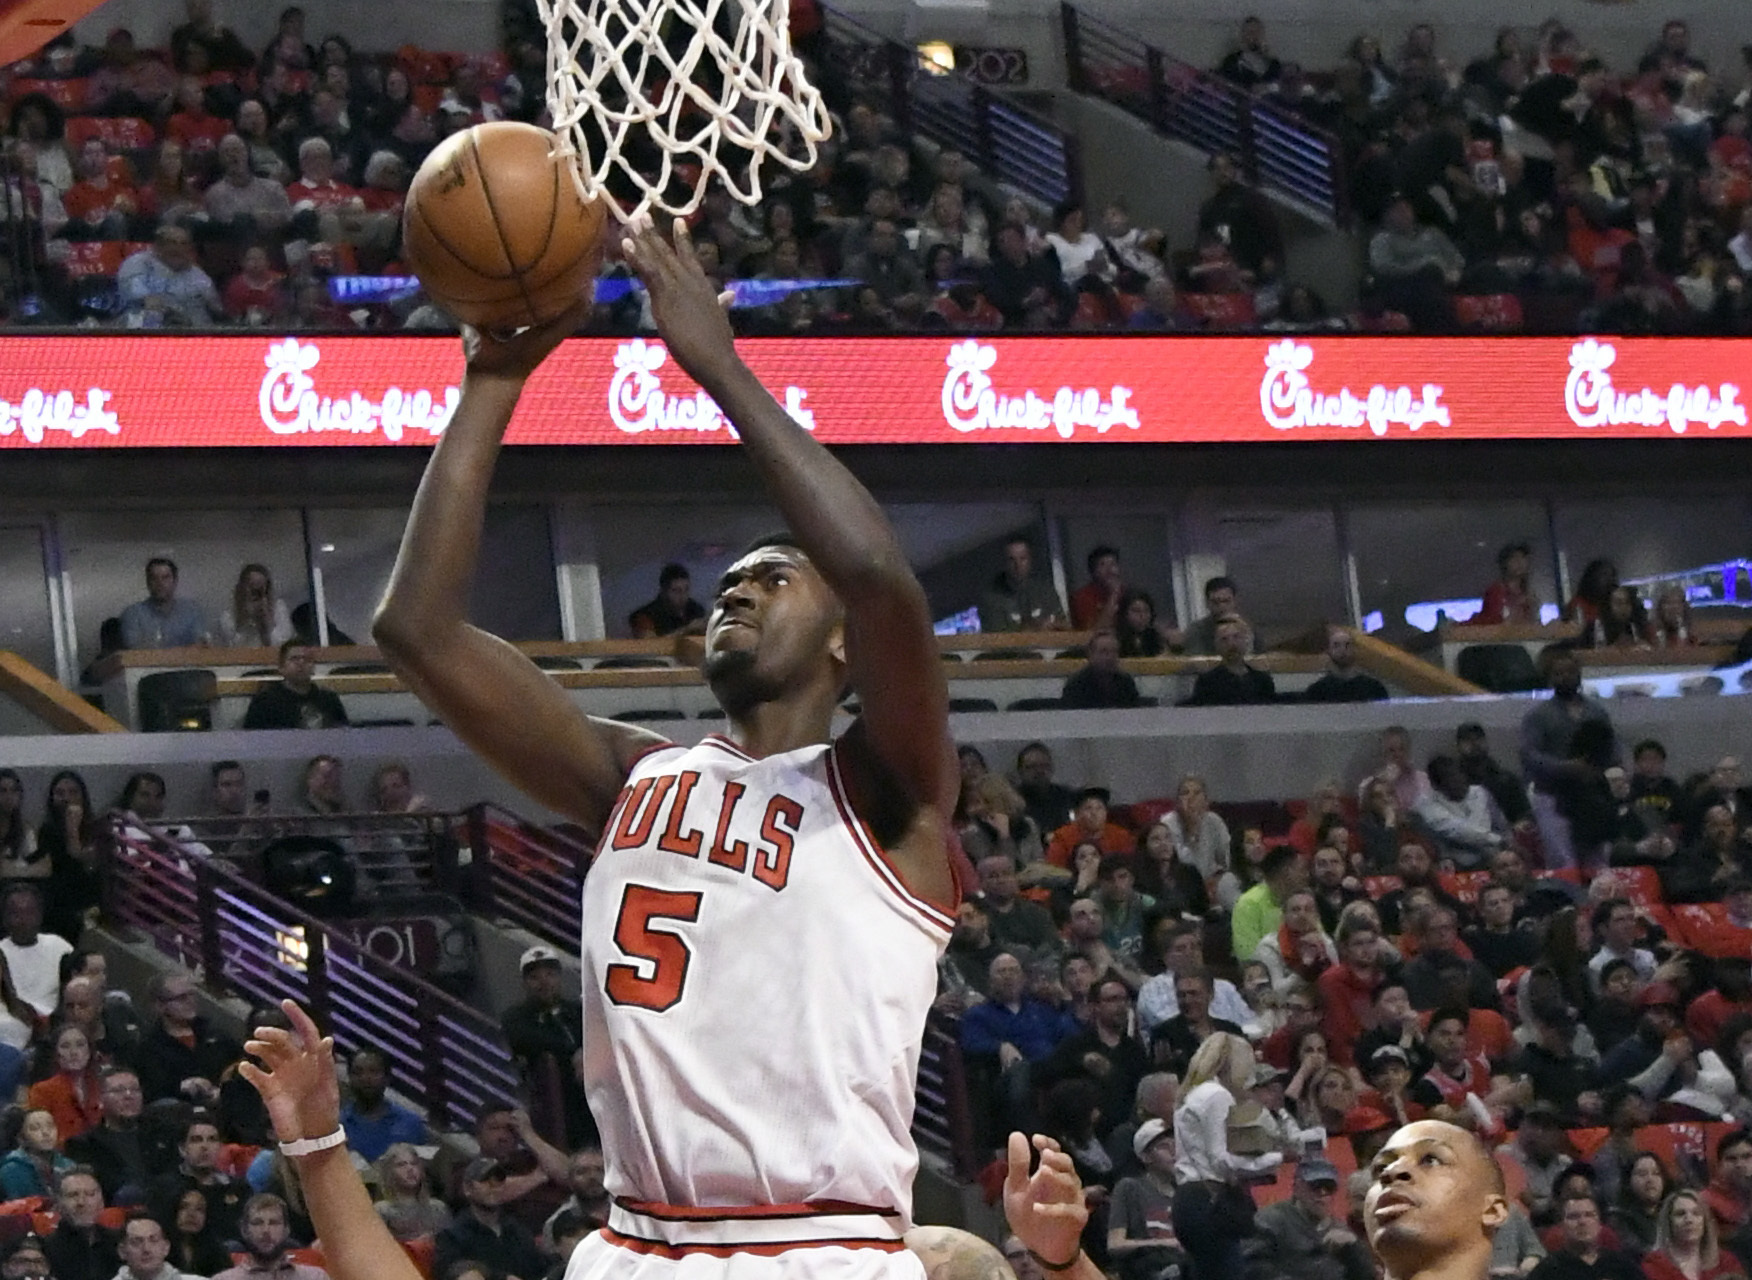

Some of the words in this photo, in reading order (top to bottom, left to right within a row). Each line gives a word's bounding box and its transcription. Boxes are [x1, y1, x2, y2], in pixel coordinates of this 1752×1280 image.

[941, 342, 1141, 438] Chick-fil-A
[1260, 342, 1451, 436] Chick-fil-A
[1565, 342, 1747, 433] Chick-fil-A
[604, 882, 704, 1013] 5
